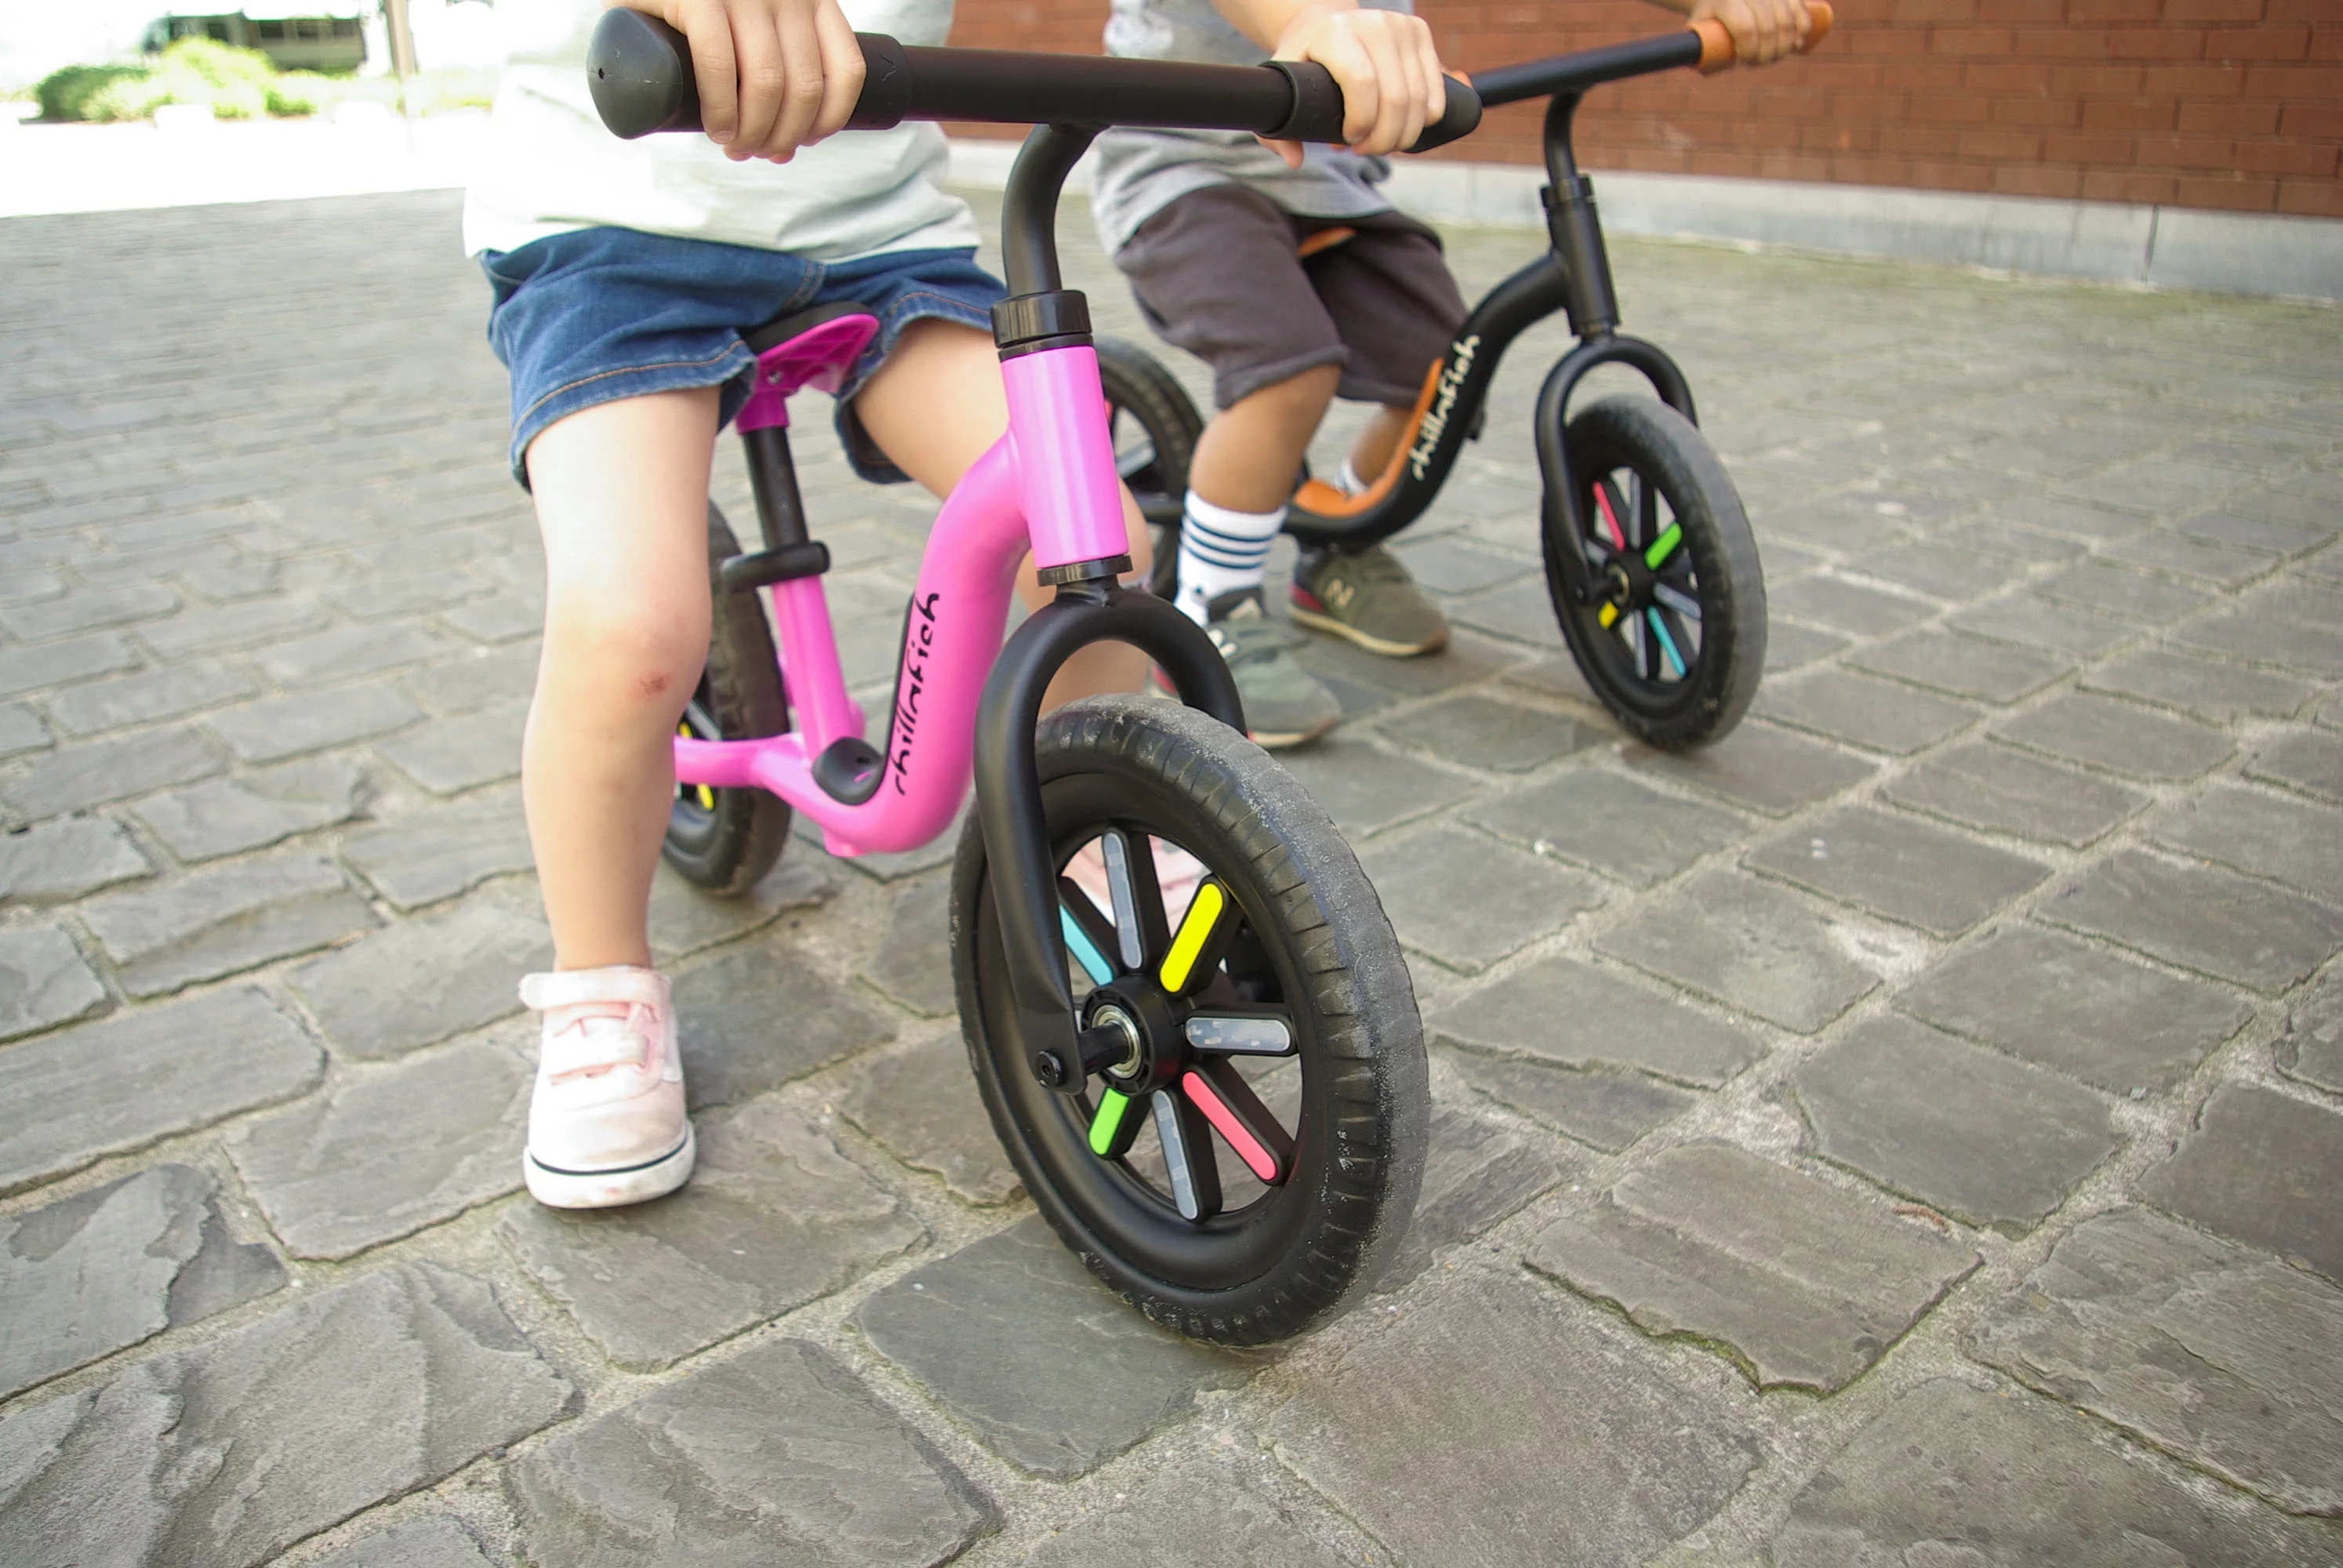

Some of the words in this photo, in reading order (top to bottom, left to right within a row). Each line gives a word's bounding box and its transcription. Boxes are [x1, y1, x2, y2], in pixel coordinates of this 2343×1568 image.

[1408, 334, 1481, 481] chillafish
[1325, 578, 1355, 608] N
[889, 592, 940, 796] chillafish
